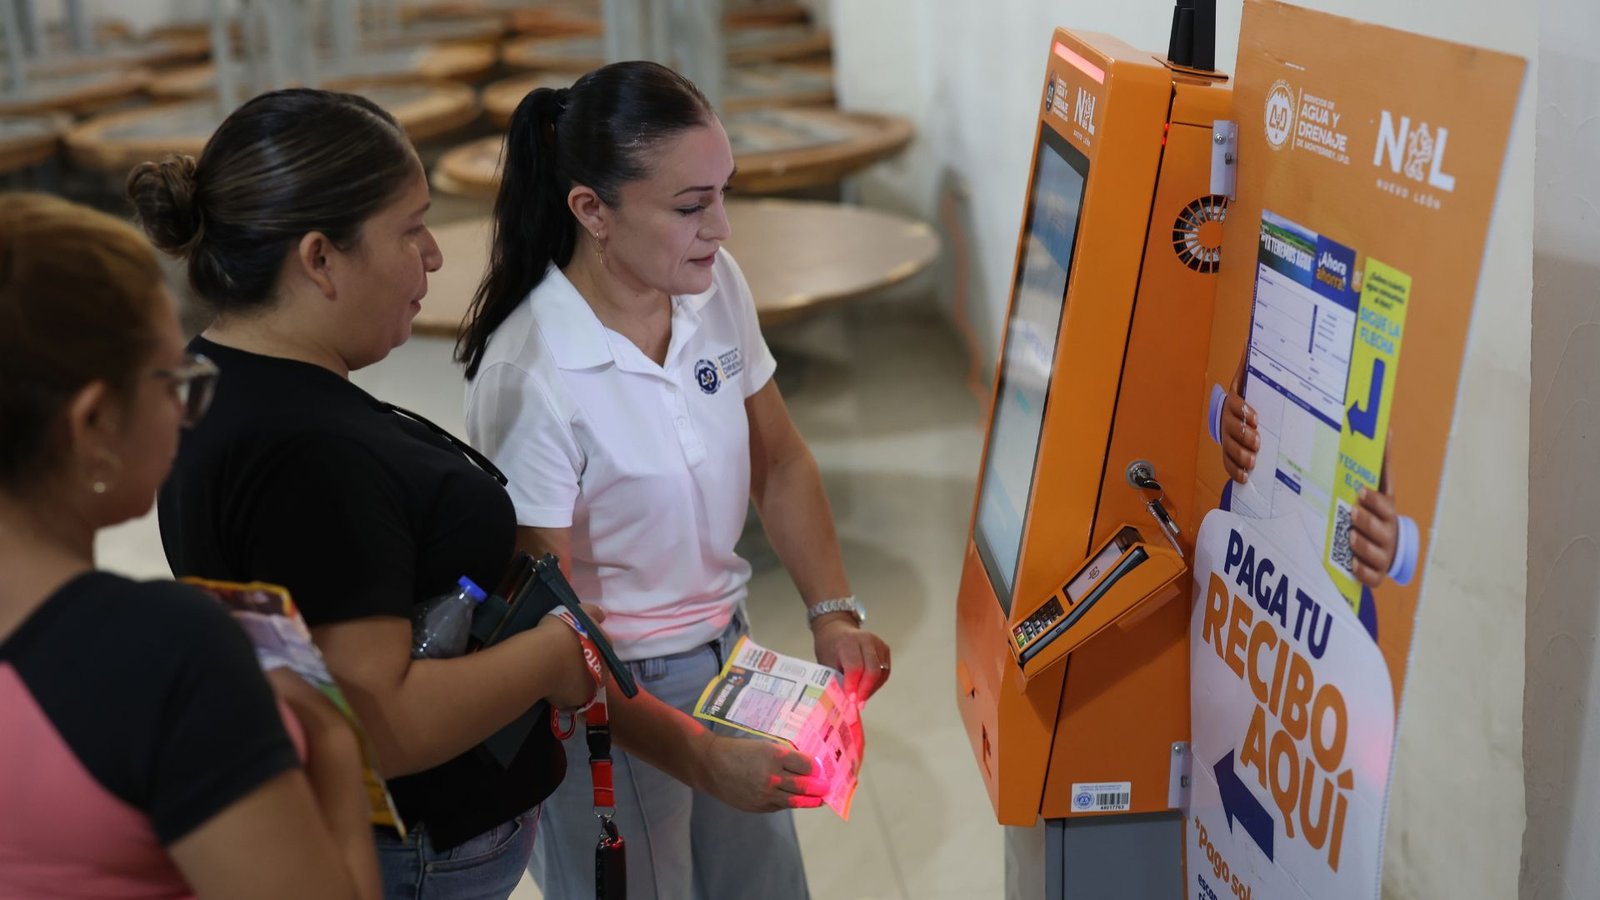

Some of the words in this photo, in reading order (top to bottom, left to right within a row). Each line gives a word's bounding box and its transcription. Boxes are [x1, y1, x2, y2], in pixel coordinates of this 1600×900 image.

[1301, 103, 1329, 126] AGUA
[1332, 112, 1341, 128] Y
[1298, 121, 1348, 153] DRENAJE
[1376, 179, 1409, 199] NUEVO
[1318, 251, 1348, 277] ¡Ahora
[1360, 306, 1387, 333] SIGUE
[1387, 320, 1402, 338] LA
[1360, 326, 1395, 355] FLECHA
[1223, 528, 1289, 629] PAGA
[1294, 587, 1333, 660] TU
[1202, 571, 1348, 773] RECIBO
[1240, 703, 1354, 873] AQUÍ
[1231, 874, 1252, 900] sol
